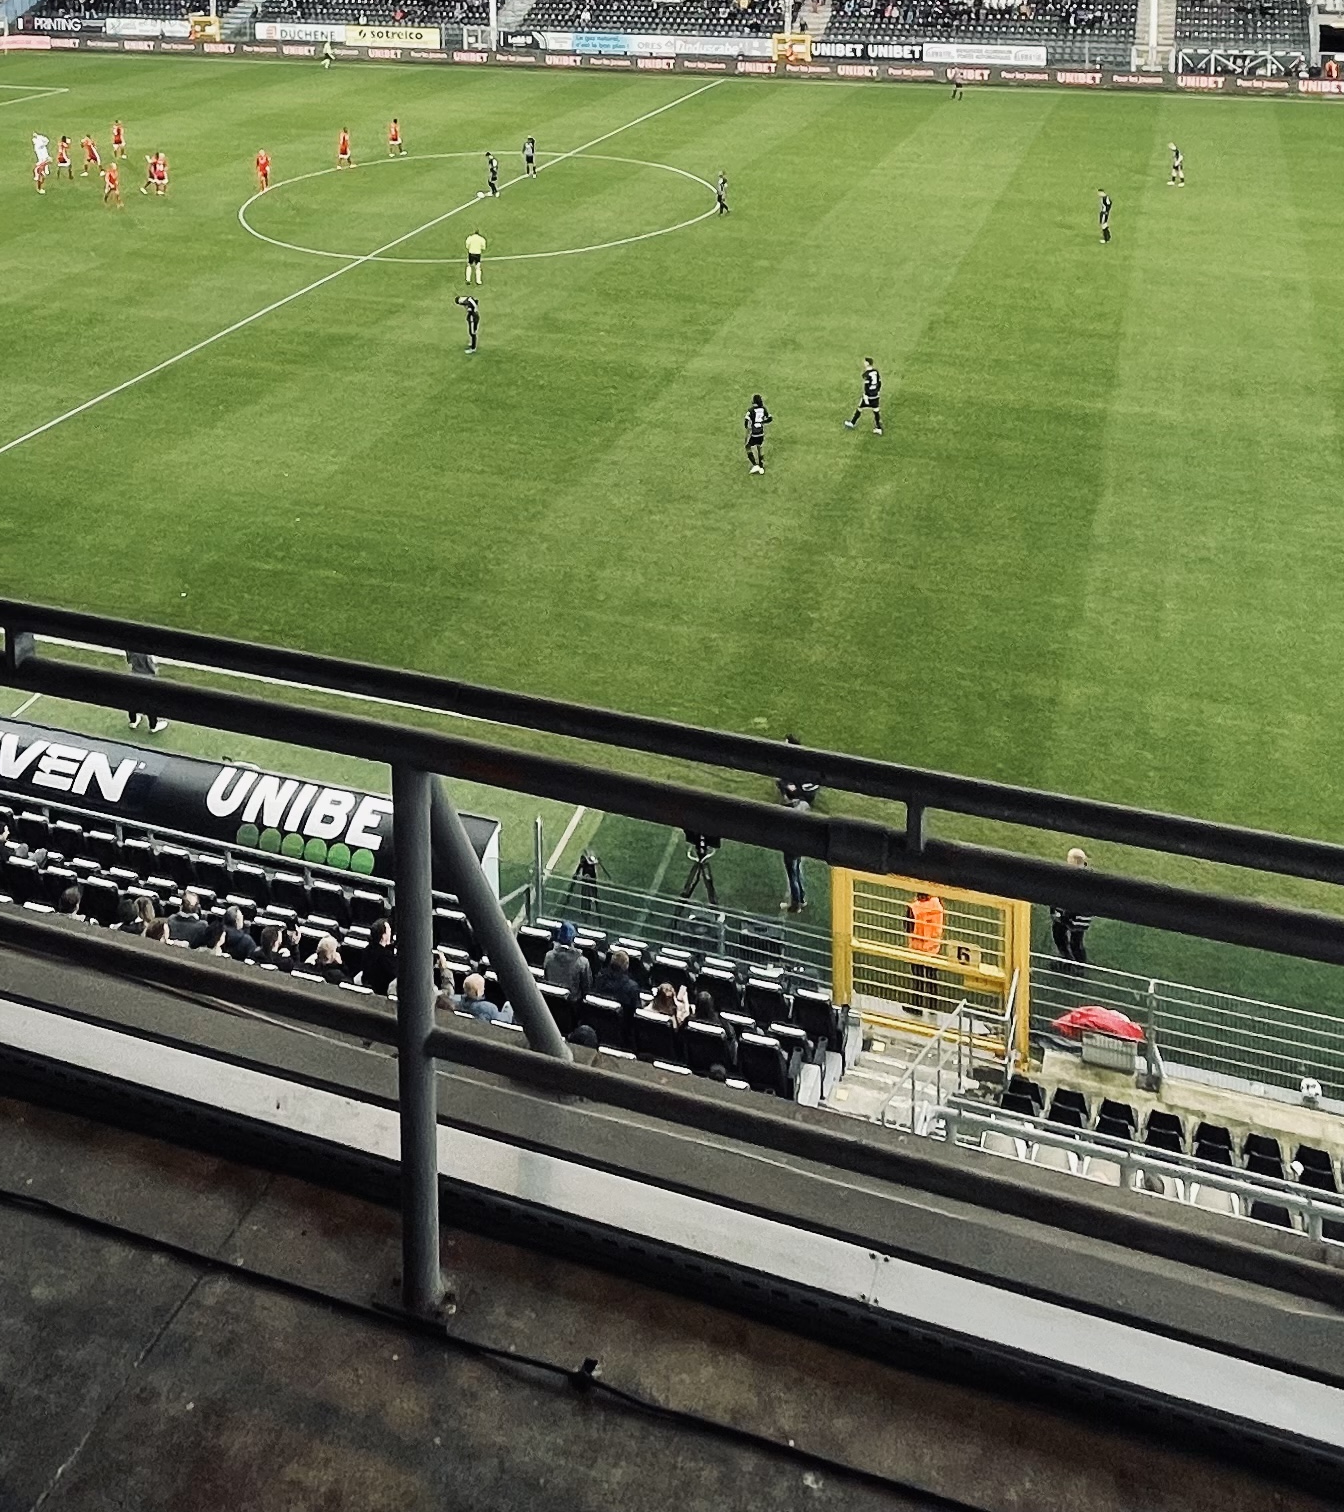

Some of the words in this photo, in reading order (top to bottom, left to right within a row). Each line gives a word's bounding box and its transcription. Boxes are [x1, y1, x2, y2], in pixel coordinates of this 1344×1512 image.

[34, 18, 82, 32] PRINTING
[280, 29, 336, 41] DUCHENE
[283, 45, 316, 56] UNIBET
[637, 41, 663, 50] ORES
[811, 42, 864, 57] UNIBET
[868, 44, 922, 59] UNIBET
[368, 48, 403, 59] UNIBET
[453, 50, 489, 63] UNIBET
[545, 53, 582, 66] UNIBET
[637, 58, 675, 70] UNIBET
[737, 60, 777, 73] UNIBET
[838, 65, 879, 77] UNIBET
[1057, 71, 1102, 85] UNIBET
[1178, 75, 1225, 88] UNIBET
[206, 766, 394, 851] UNIBE
[957, 946, 971, 965] 6
